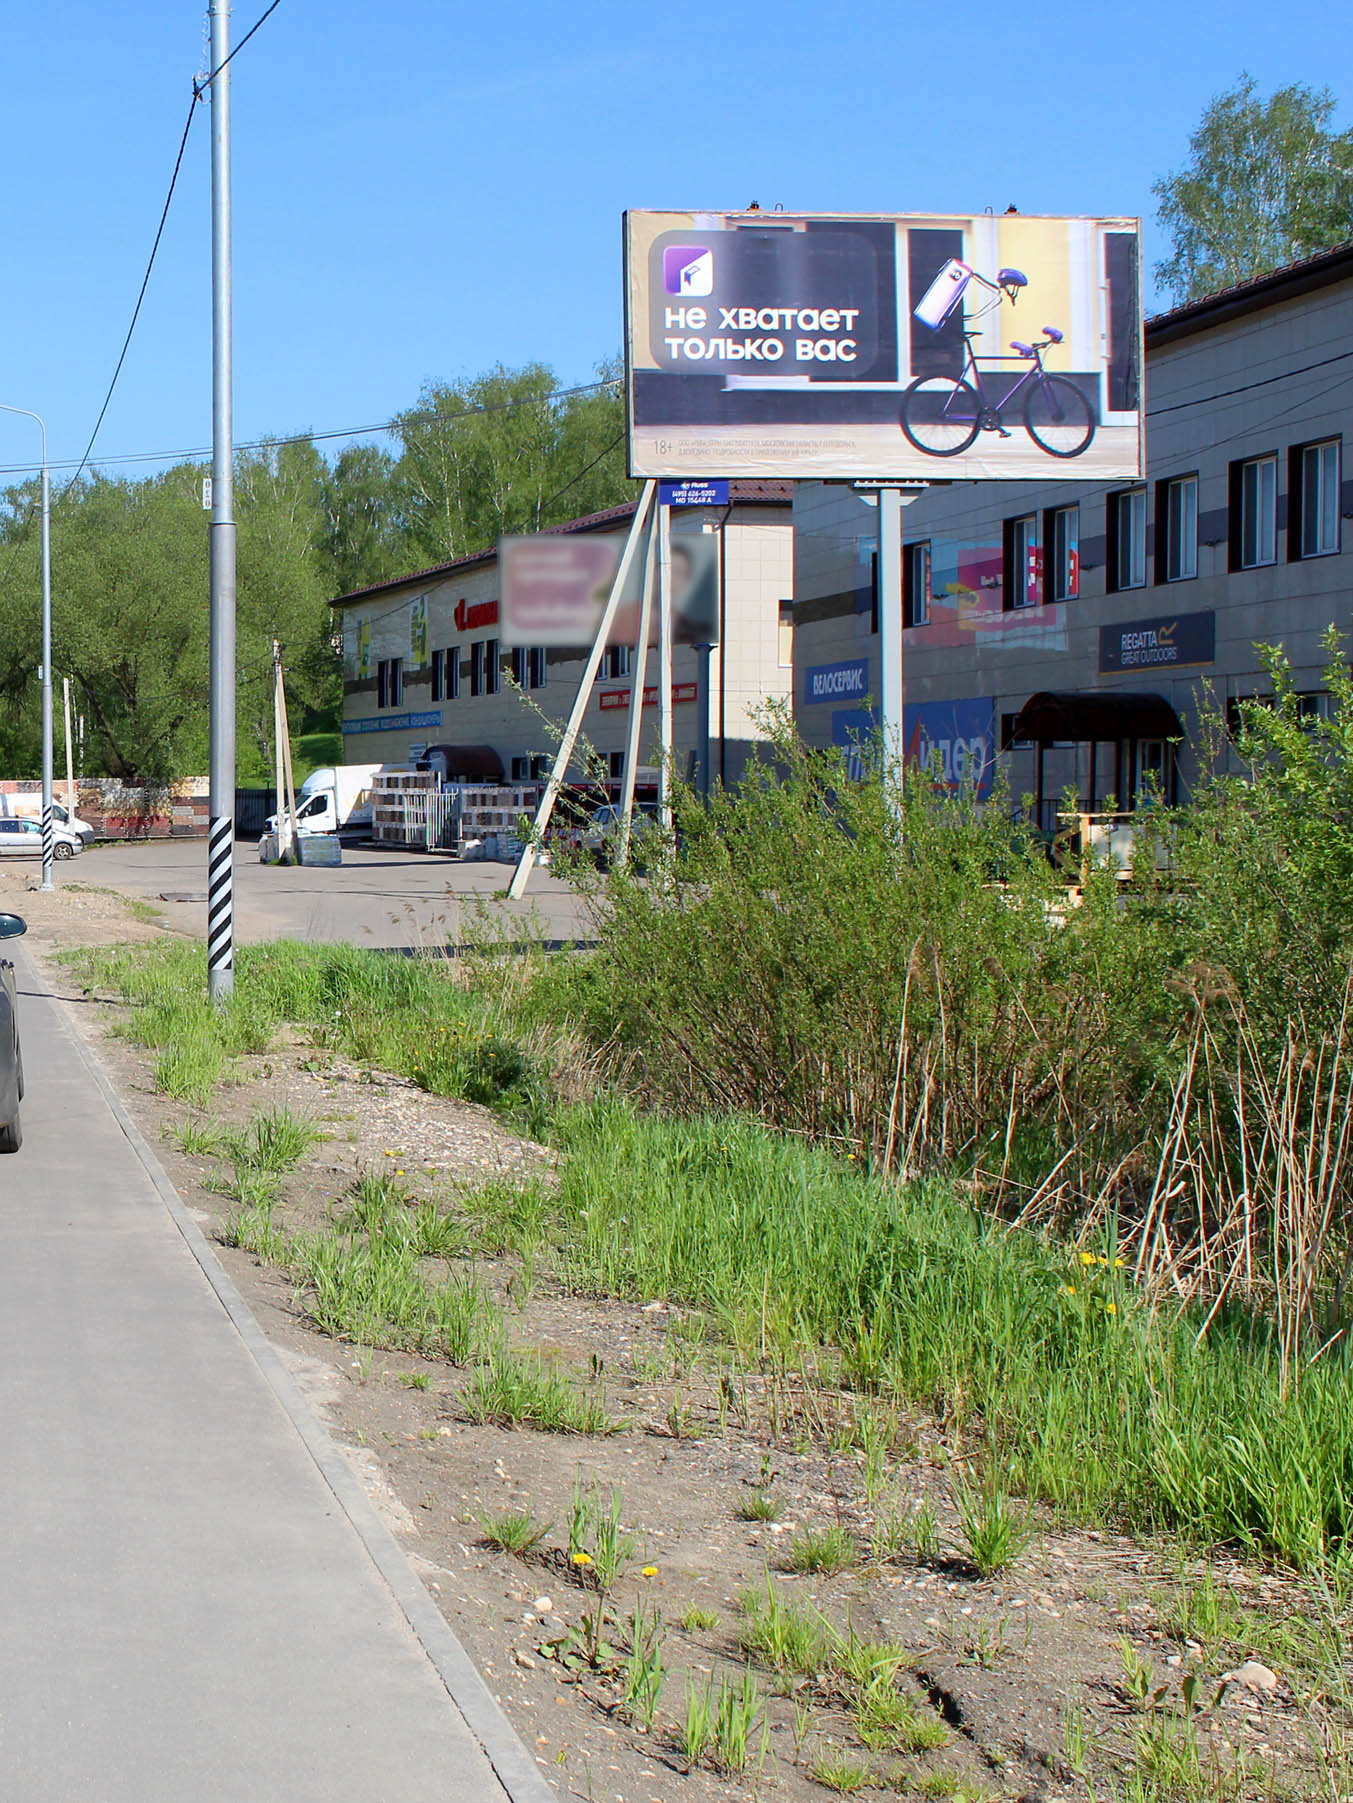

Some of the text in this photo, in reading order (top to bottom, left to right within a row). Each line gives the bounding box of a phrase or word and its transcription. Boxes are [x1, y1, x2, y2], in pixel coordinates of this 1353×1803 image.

[664, 306, 859, 331] не хватает
[664, 337, 857, 361] только вас
[654, 440, 673, 455] 18+
[1121, 631, 1158, 650] REGATTA
[1121, 647, 1177, 665] GREAT OUTDOORS
[813, 668, 864, 695] ВЕЛОСЕРВИС
